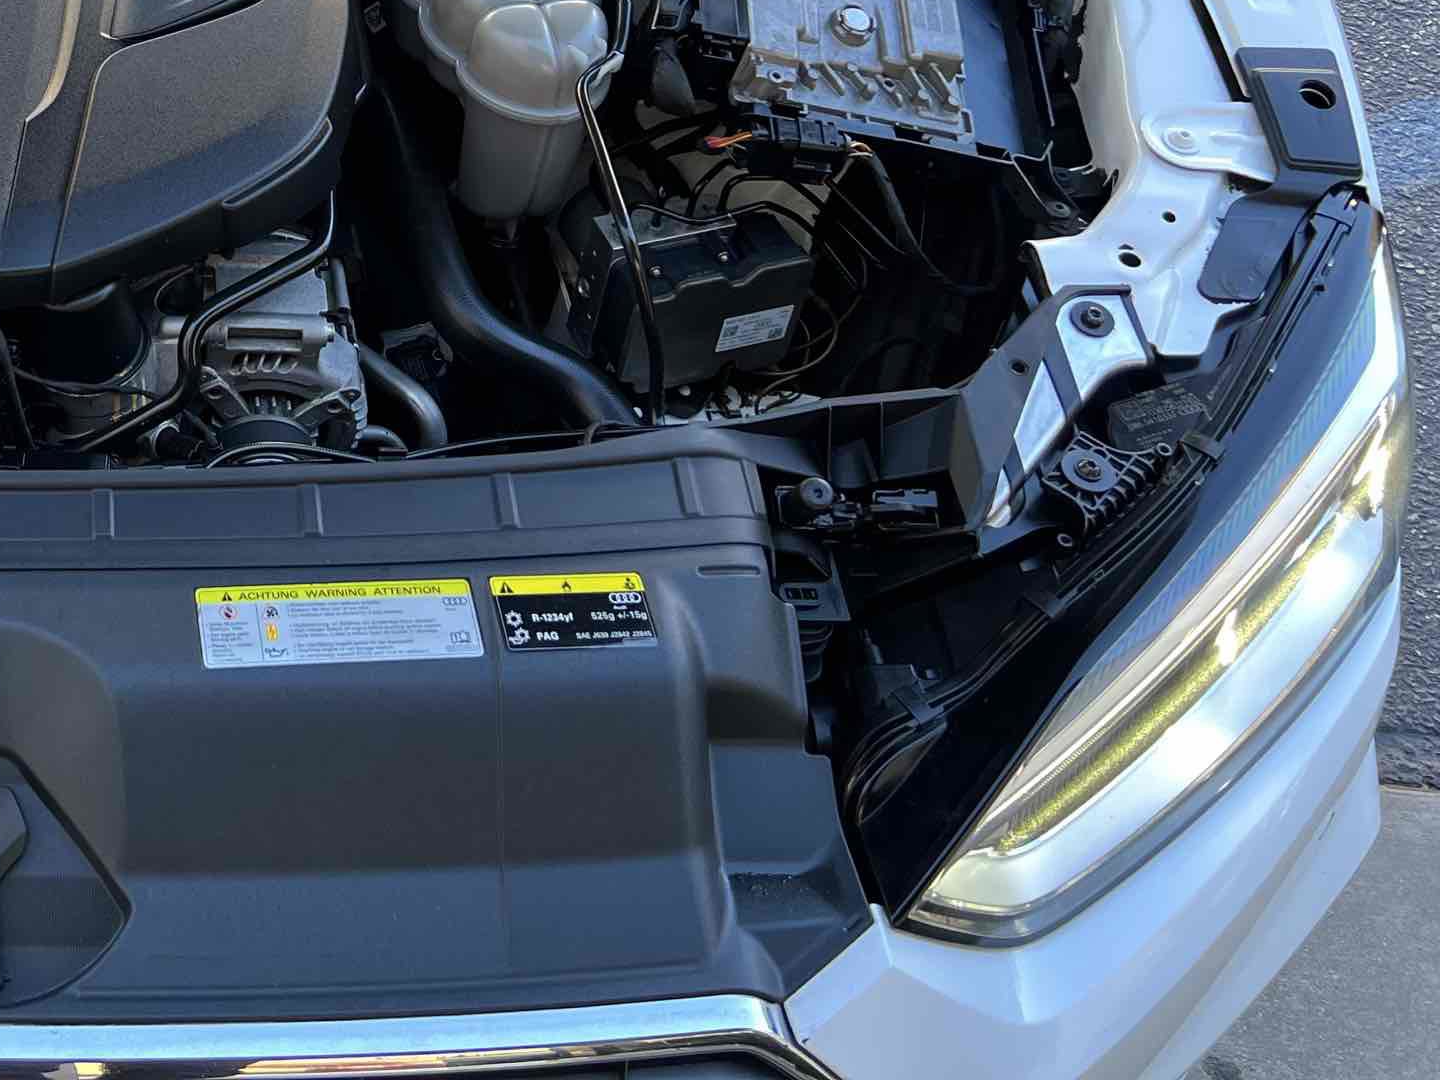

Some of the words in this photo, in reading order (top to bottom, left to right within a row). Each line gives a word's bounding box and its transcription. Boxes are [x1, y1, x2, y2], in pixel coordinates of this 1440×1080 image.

[238, 590, 299, 601] ACHTUNG
[305, 587, 368, 598] WARNING
[373, 585, 442, 596] ATTENTION
[536, 631, 560, 641] PAG
